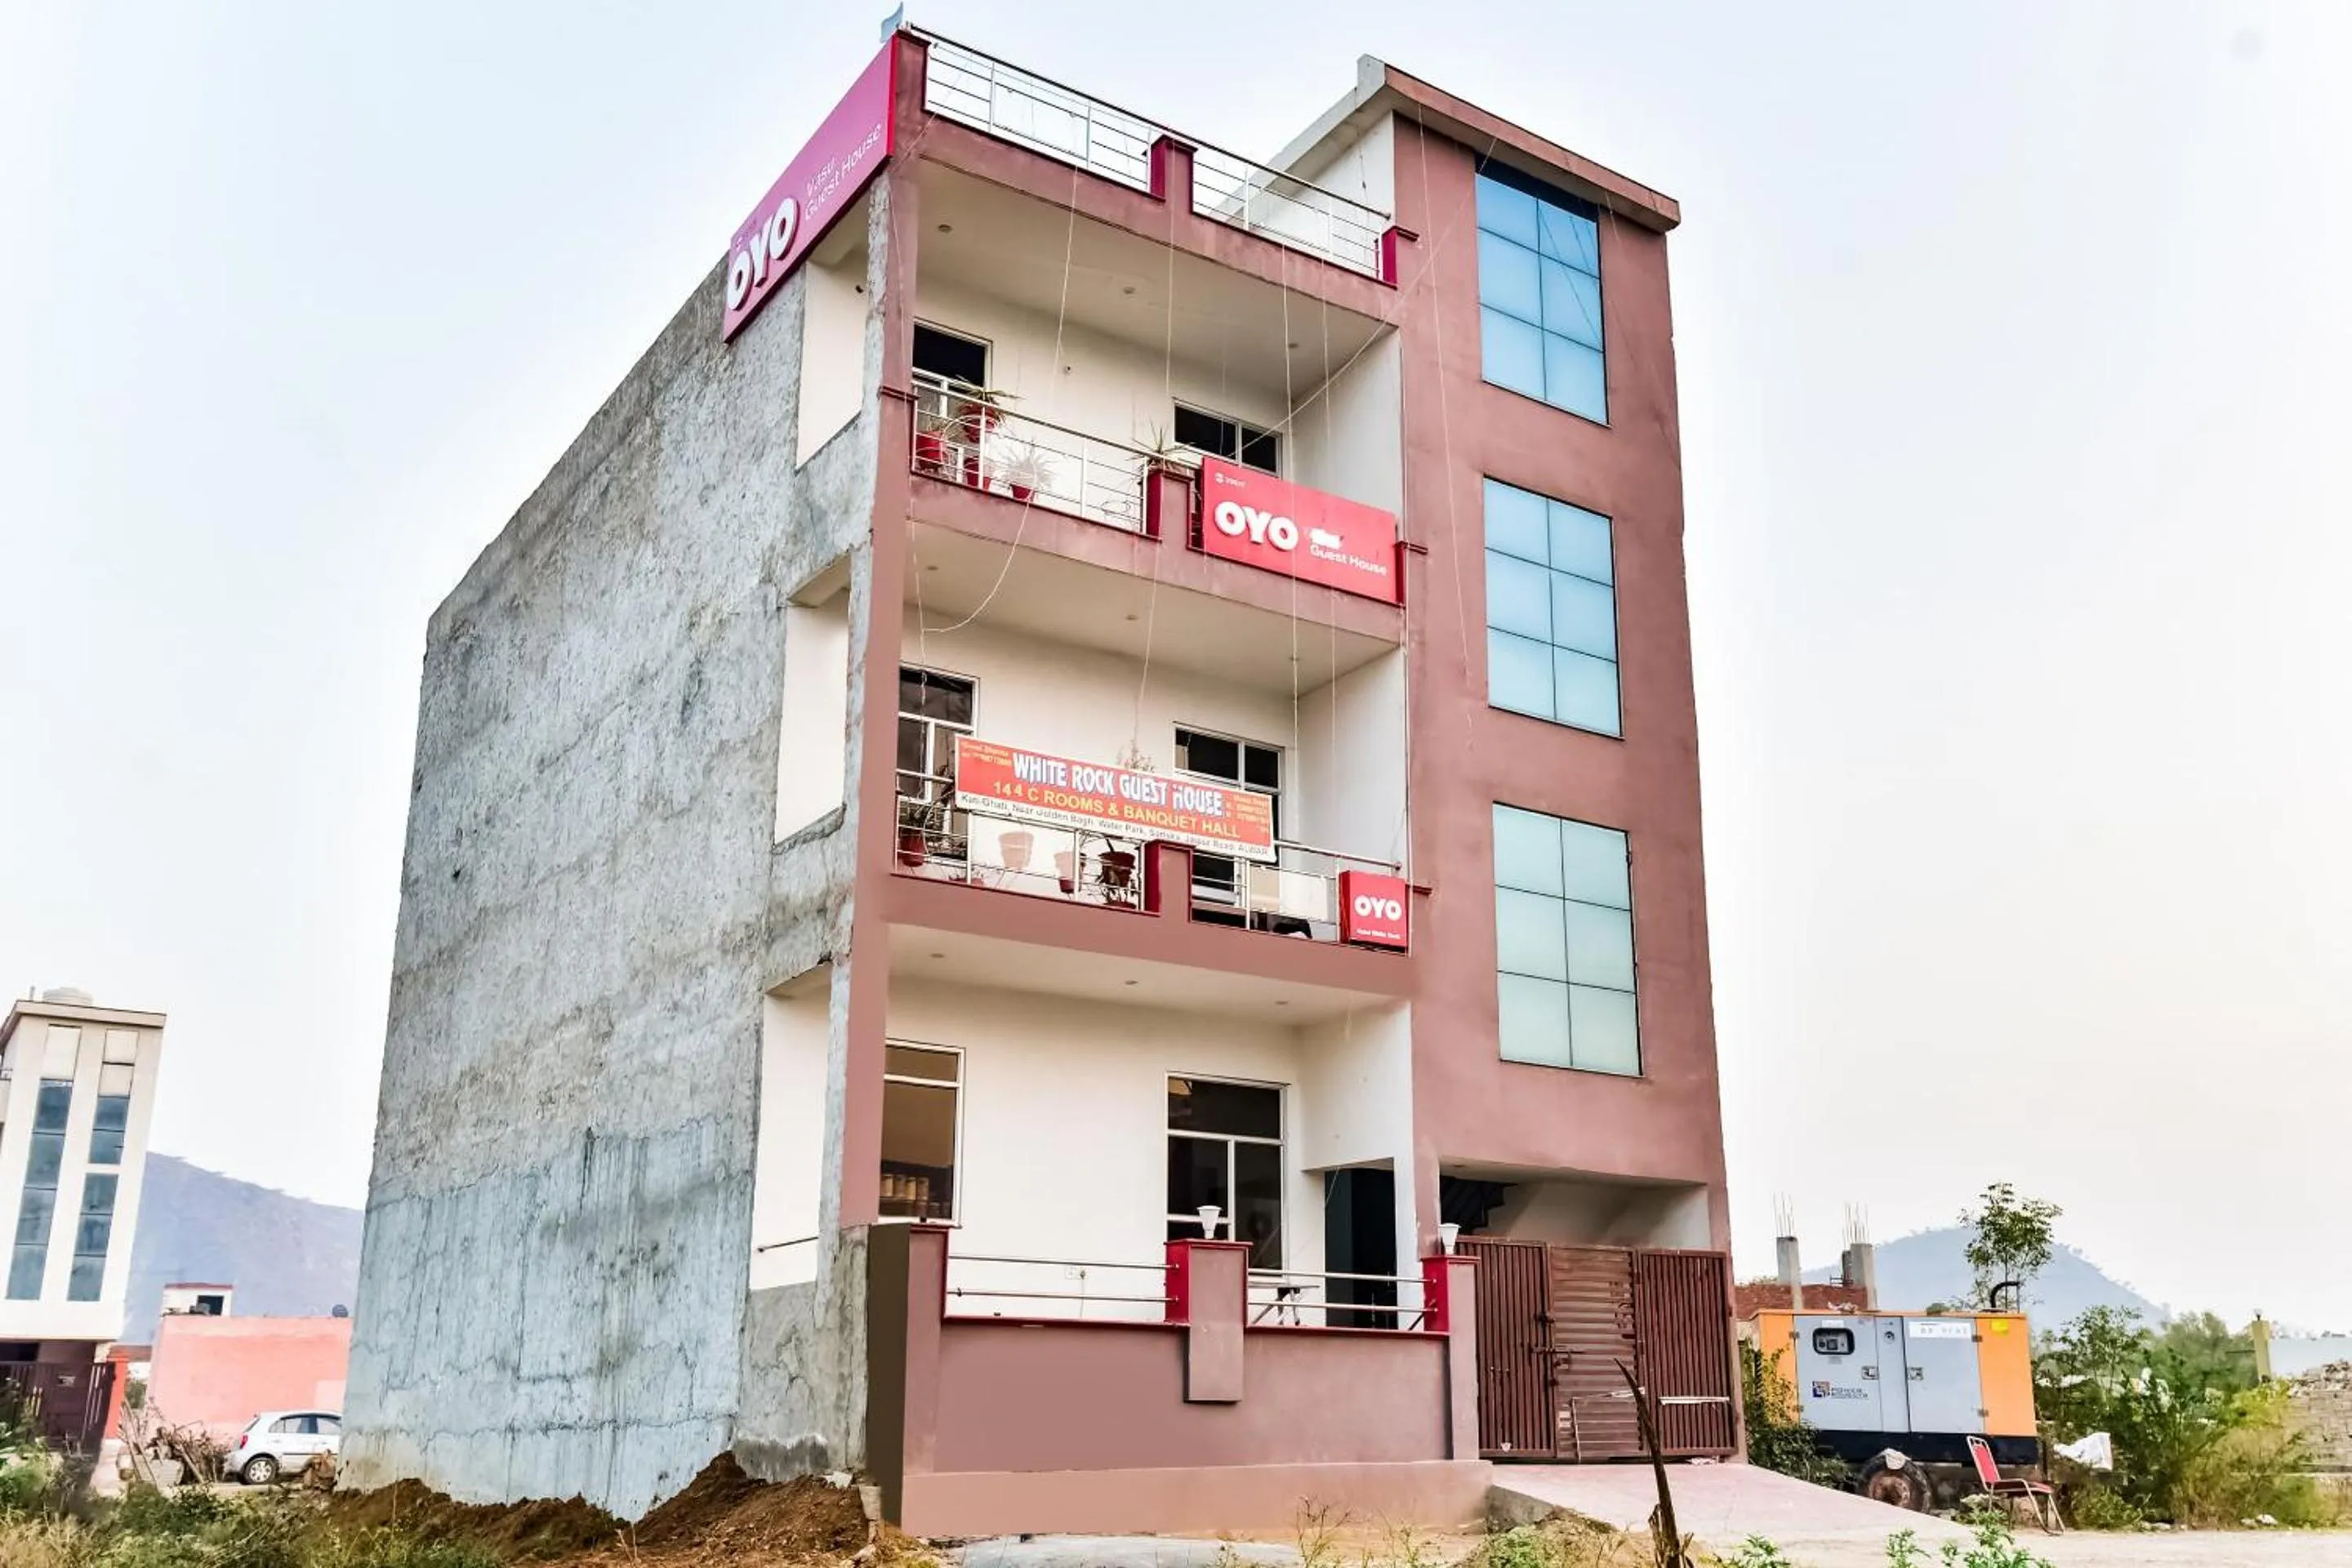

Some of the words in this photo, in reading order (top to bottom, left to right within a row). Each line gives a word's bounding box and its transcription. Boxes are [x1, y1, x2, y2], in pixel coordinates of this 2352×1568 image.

[804, 171, 840, 221] Guest
[842, 123, 881, 180] House
[728, 198, 800, 311] OYO
[1214, 501, 1299, 551] OYO
[1310, 544, 1348, 565] Guest
[1349, 555, 1387, 577] House
[1013, 751, 1067, 787] WHITE
[1071, 764, 1115, 795] ROCK
[1120, 773, 1168, 806] GUEST
[1173, 783, 1223, 817] HOUSE
[1044, 790, 1104, 814] ROOMS
[1108, 801, 1119, 817] &
[1124, 804, 1197, 831] BANQUET
[1201, 819, 1241, 839] HALL
[1354, 895, 1402, 921] OYO
